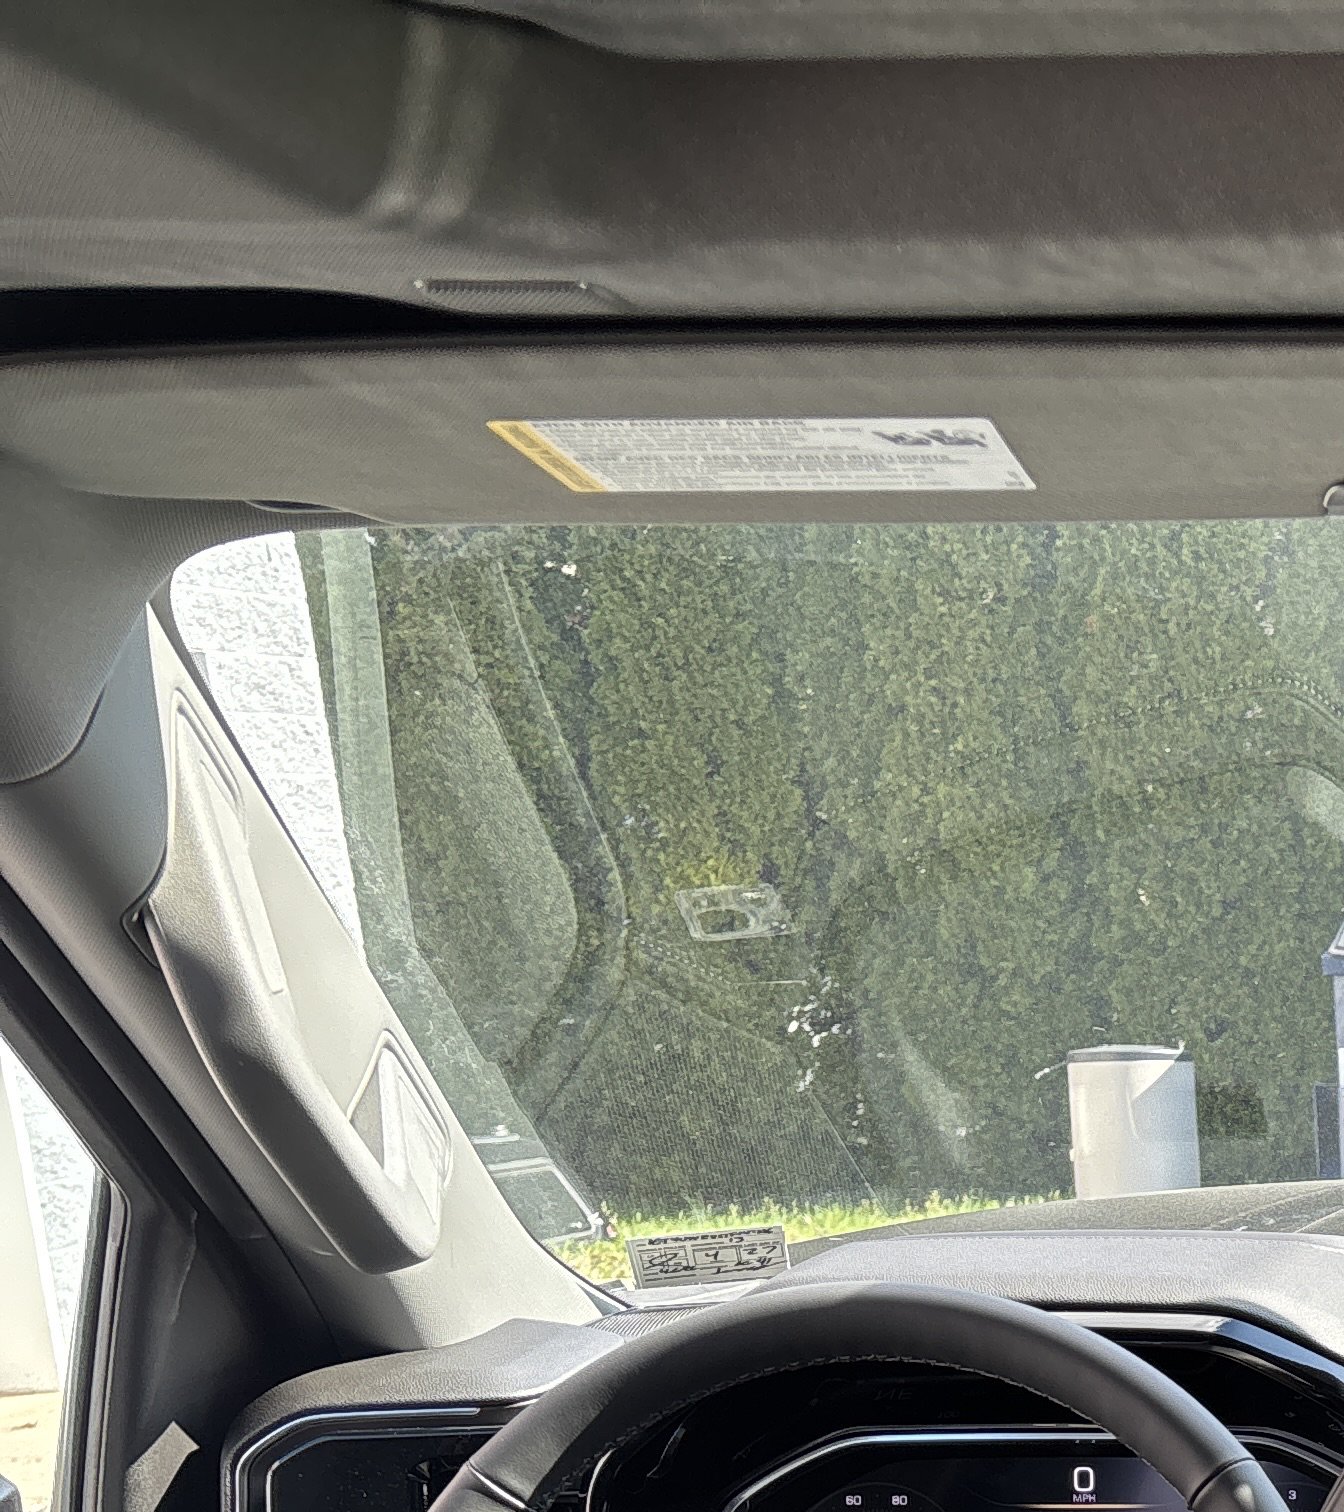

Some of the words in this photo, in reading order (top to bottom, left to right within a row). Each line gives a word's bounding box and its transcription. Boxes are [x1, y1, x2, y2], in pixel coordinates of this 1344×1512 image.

[1073, 1466, 1094, 1492] 0
[845, 1495, 861, 1505] 60
[891, 1495, 907, 1505] 80
[1072, 1494, 1096, 1502] MPH
[1288, 1490, 1297, 1500] 3
